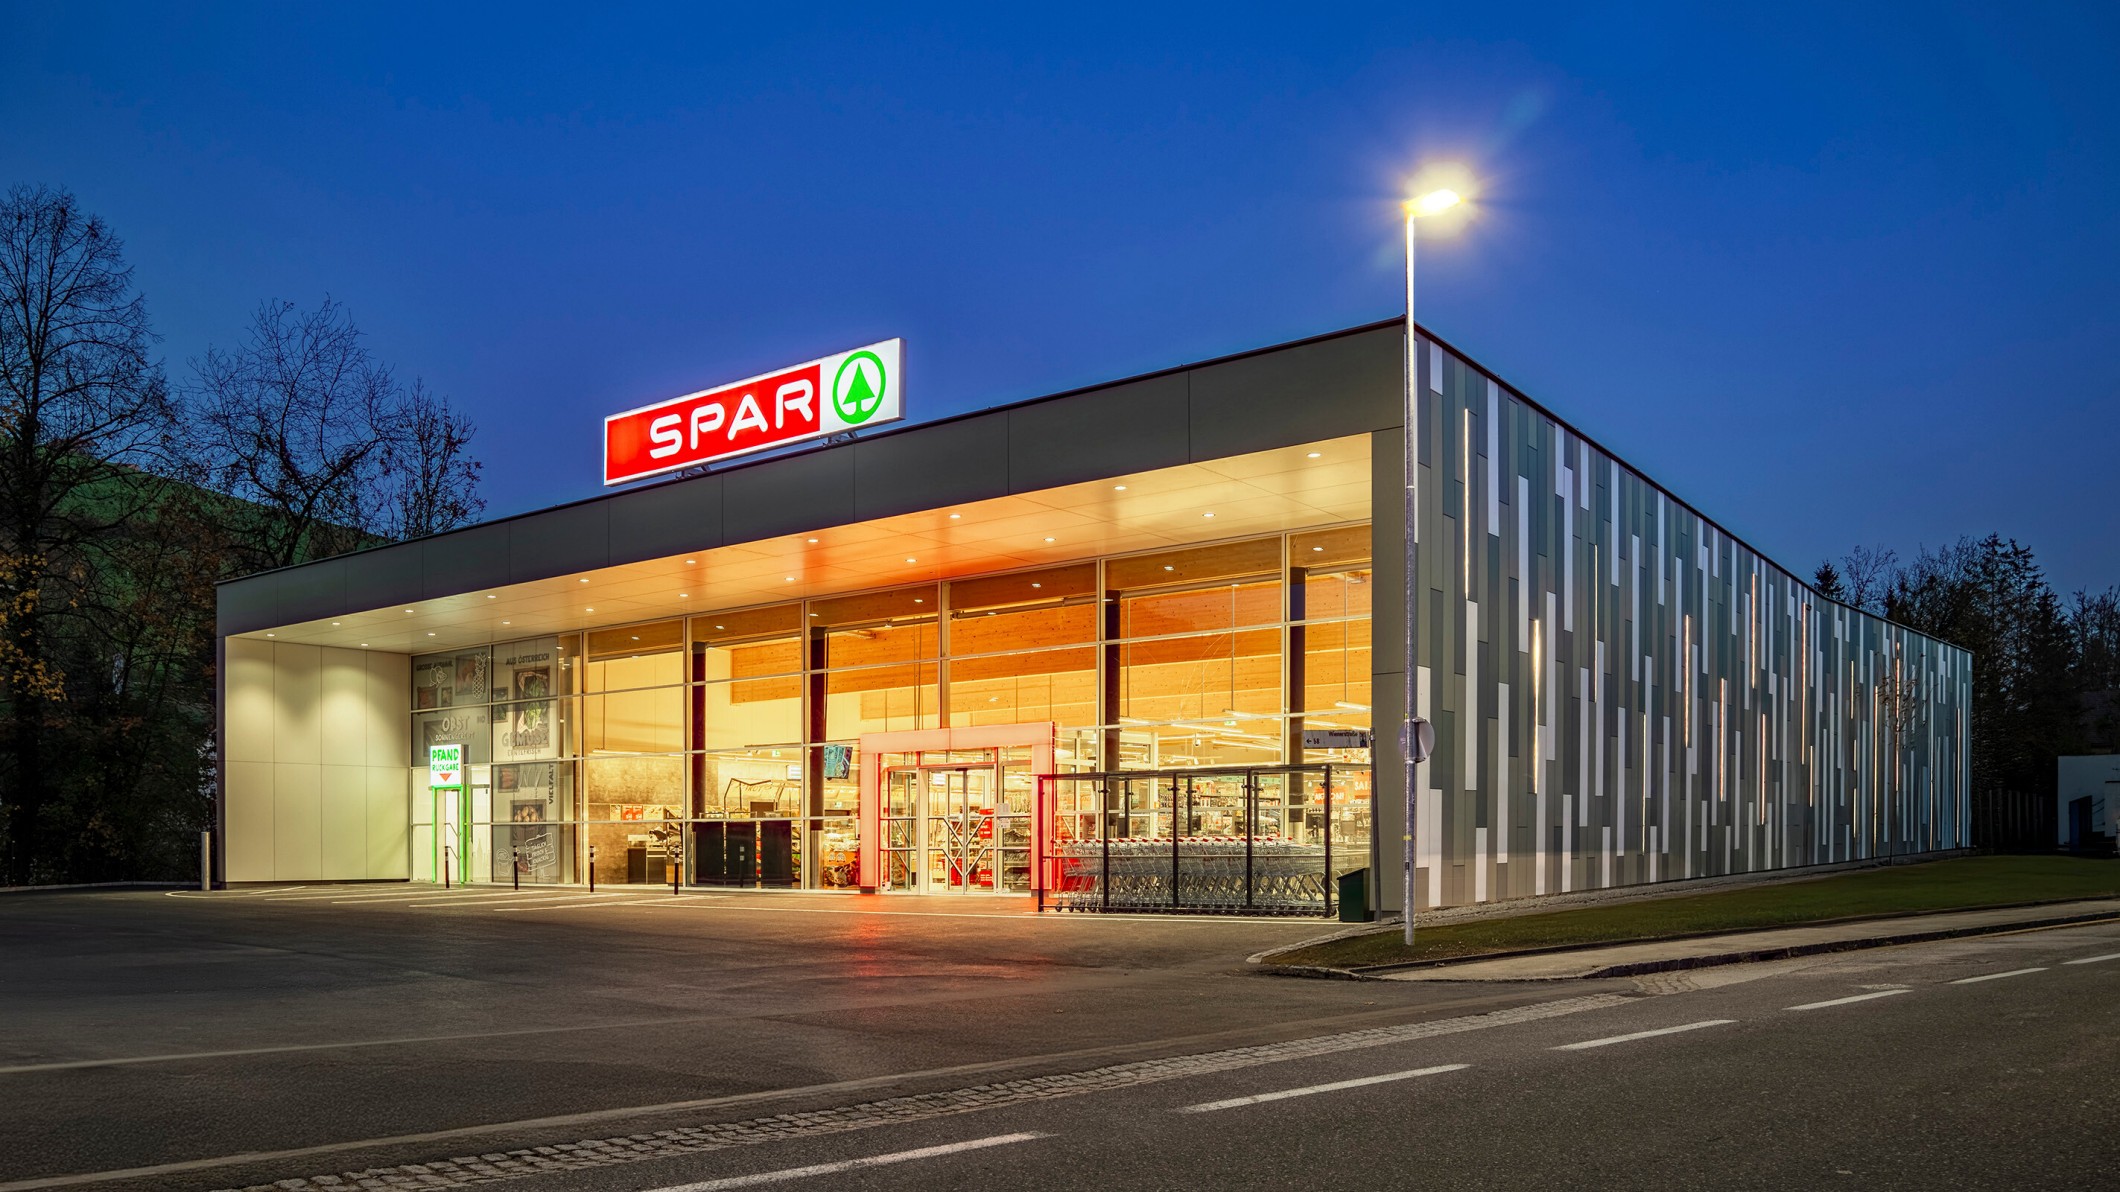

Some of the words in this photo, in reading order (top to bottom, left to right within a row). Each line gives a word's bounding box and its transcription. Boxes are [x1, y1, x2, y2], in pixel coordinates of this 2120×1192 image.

[649, 378, 814, 460] SPAR
[442, 716, 471, 732] OBST
[432, 748, 459, 762] PFAND
